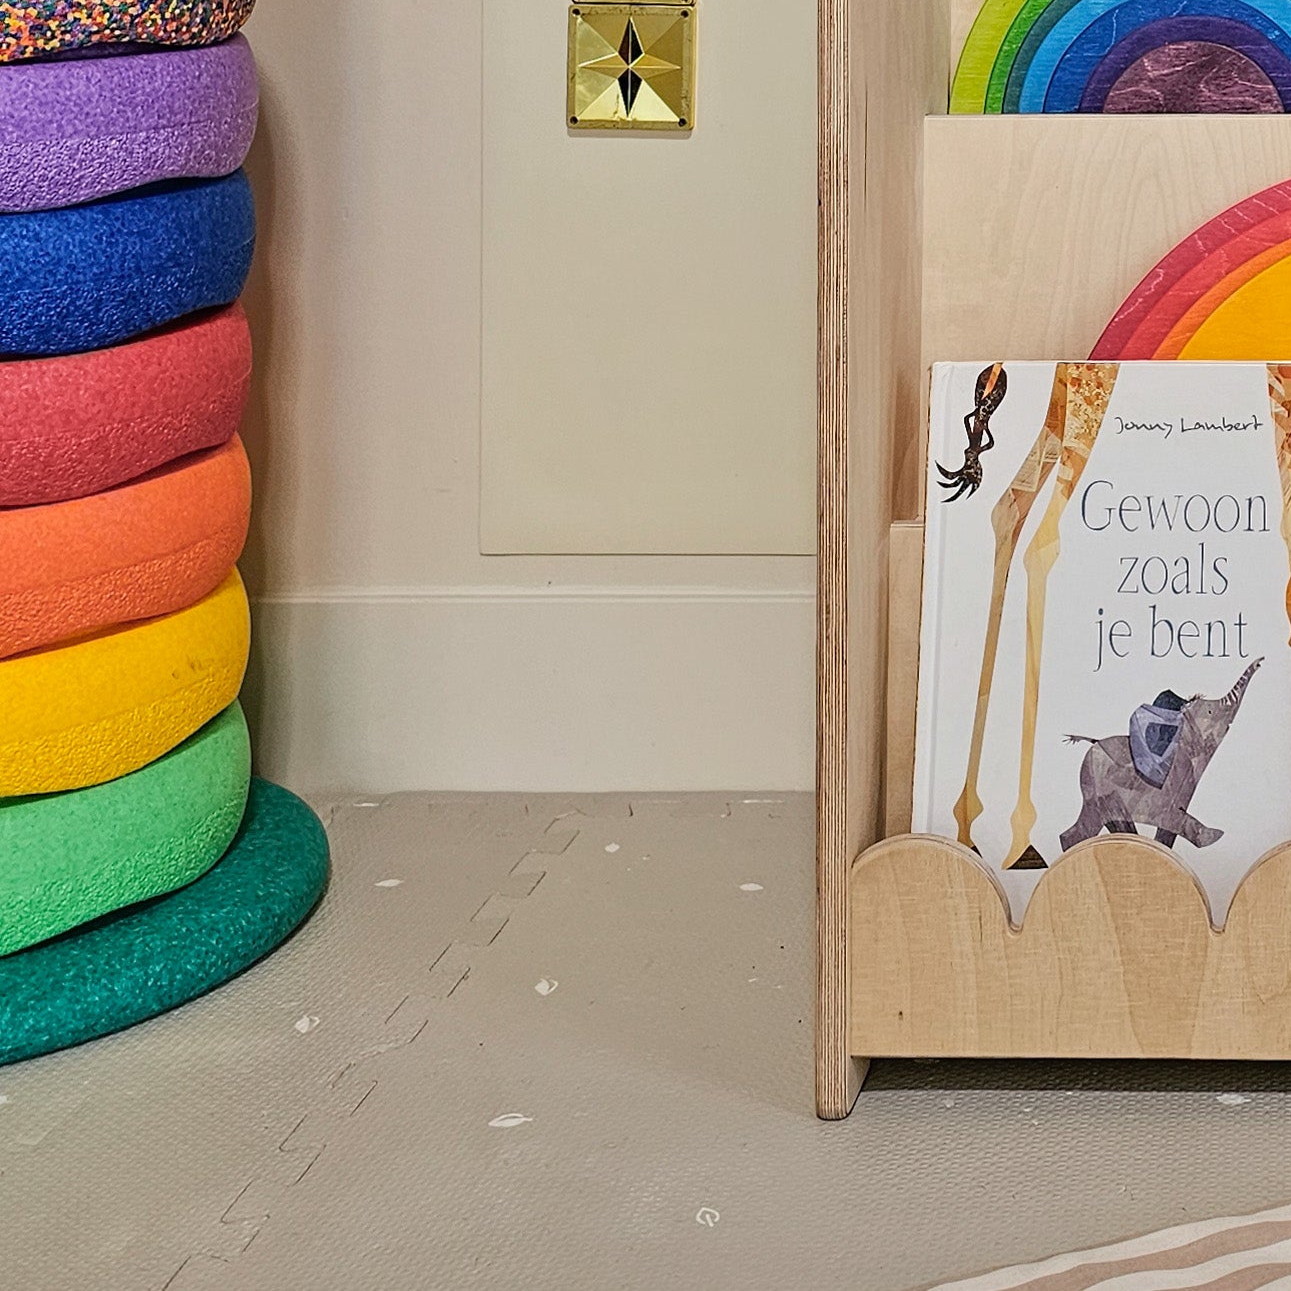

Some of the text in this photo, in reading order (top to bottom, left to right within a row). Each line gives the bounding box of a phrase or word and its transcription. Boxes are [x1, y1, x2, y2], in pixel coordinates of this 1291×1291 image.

[1114, 414, 1264, 439] Jonny Lambert
[1081, 480, 1270, 532] Gewoon
[1117, 542, 1228, 595] zoals
[1093, 604, 1249, 672] je bent
